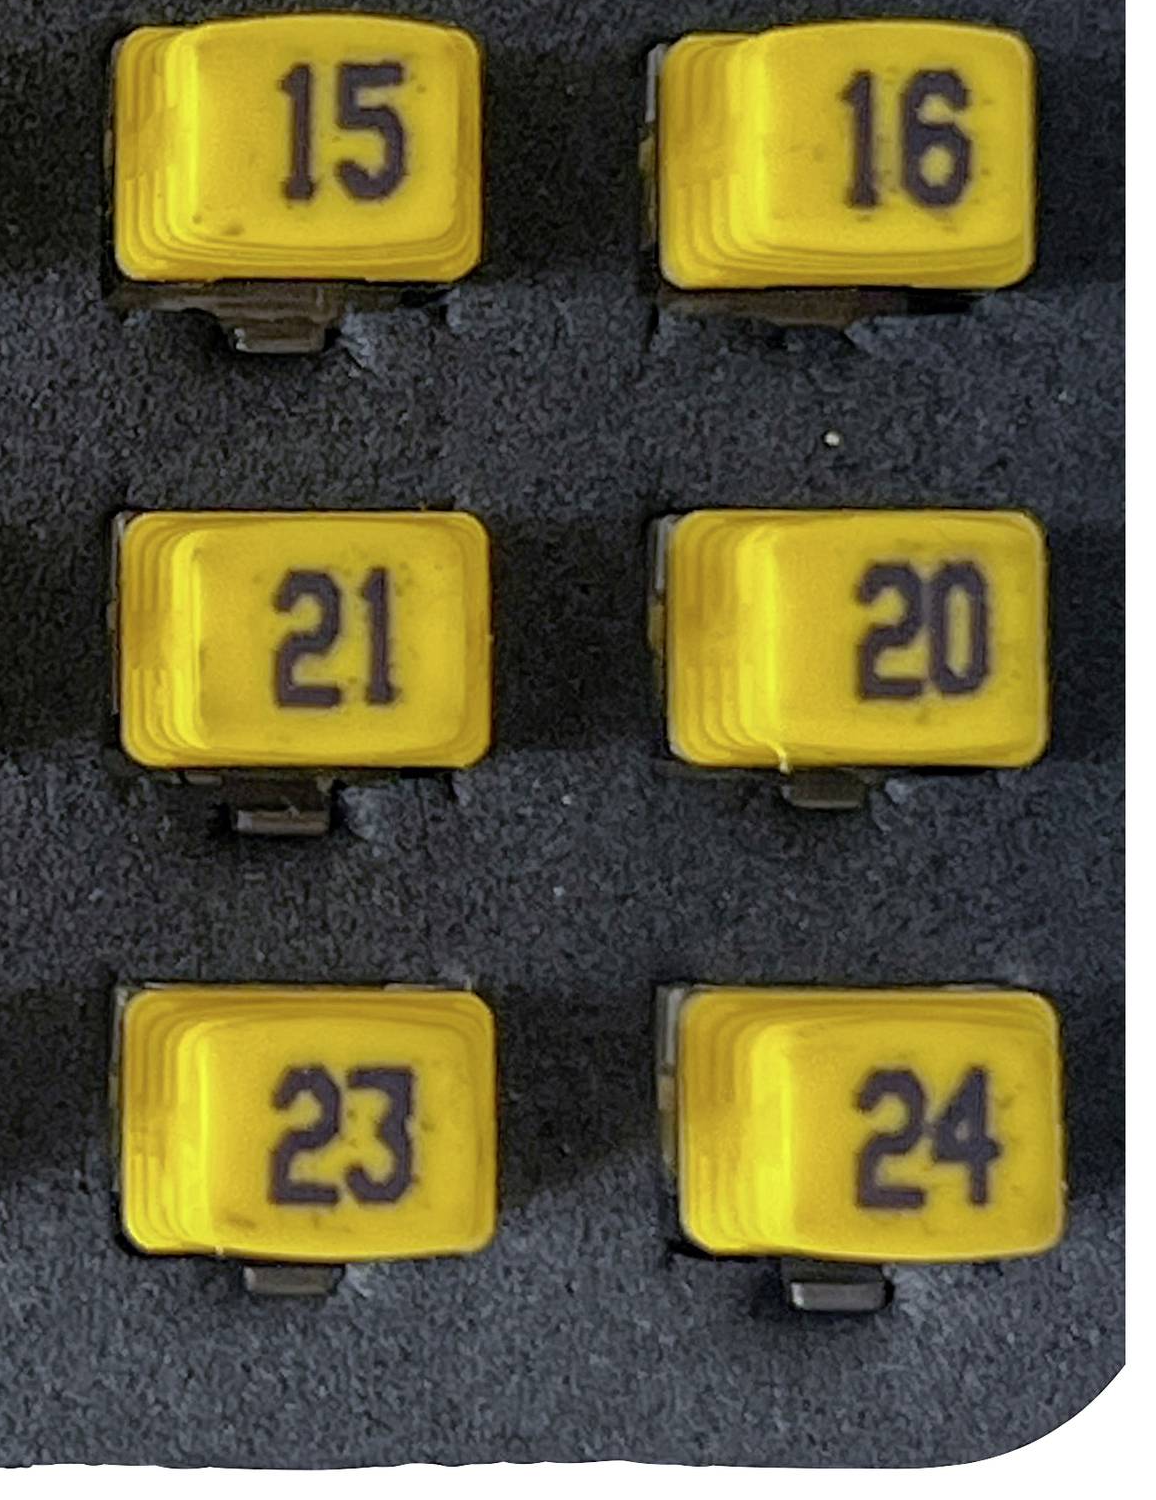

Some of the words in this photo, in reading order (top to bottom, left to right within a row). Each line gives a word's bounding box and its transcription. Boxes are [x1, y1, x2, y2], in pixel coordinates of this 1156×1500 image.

[278, 59, 410, 203] 15
[840, 68, 974, 212] 16
[272, 566, 402, 710] 21
[854, 558, 993, 702] 20
[267, 1063, 419, 1209] 23
[853, 1065, 1004, 1212] 24
